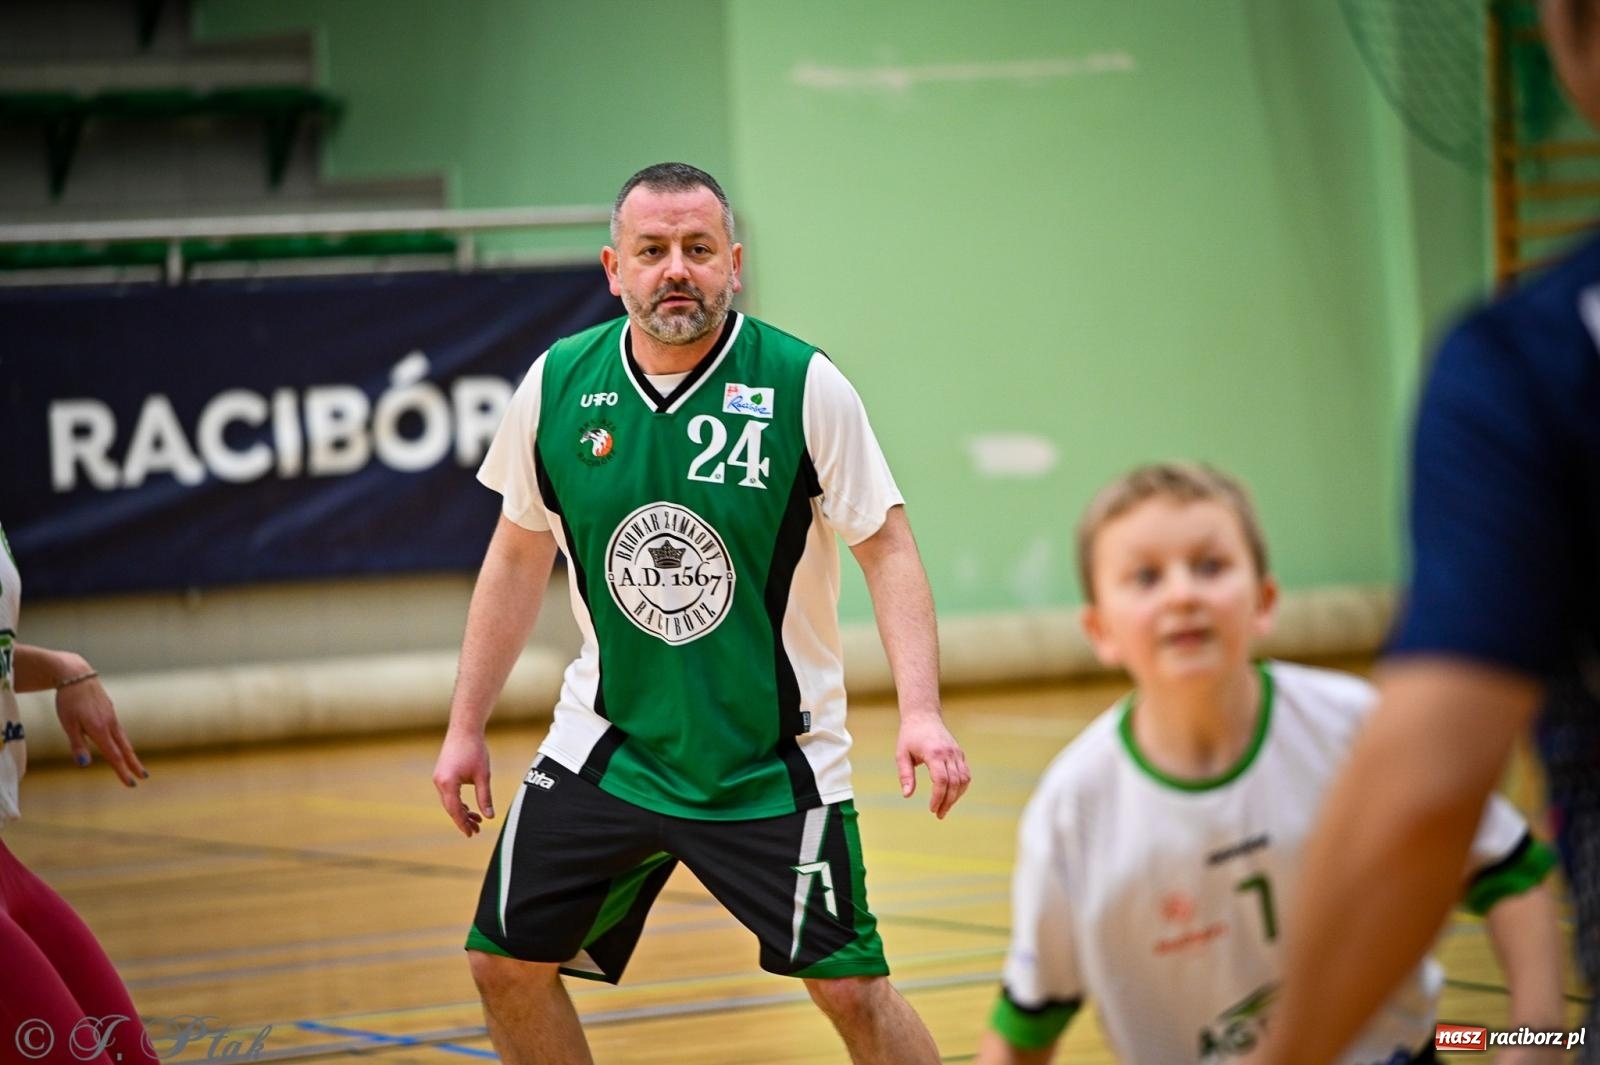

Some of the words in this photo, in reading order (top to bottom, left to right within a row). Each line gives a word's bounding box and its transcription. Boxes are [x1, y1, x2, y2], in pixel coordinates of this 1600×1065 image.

[48, 352, 520, 492] RACIBÓR
[687, 414, 770, 490] 24
[616, 512, 660, 562] BROWAR
[664, 511, 722, 561] ZAMKOWY
[618, 567, 665, 587] A.D.
[671, 561, 723, 596] 1567
